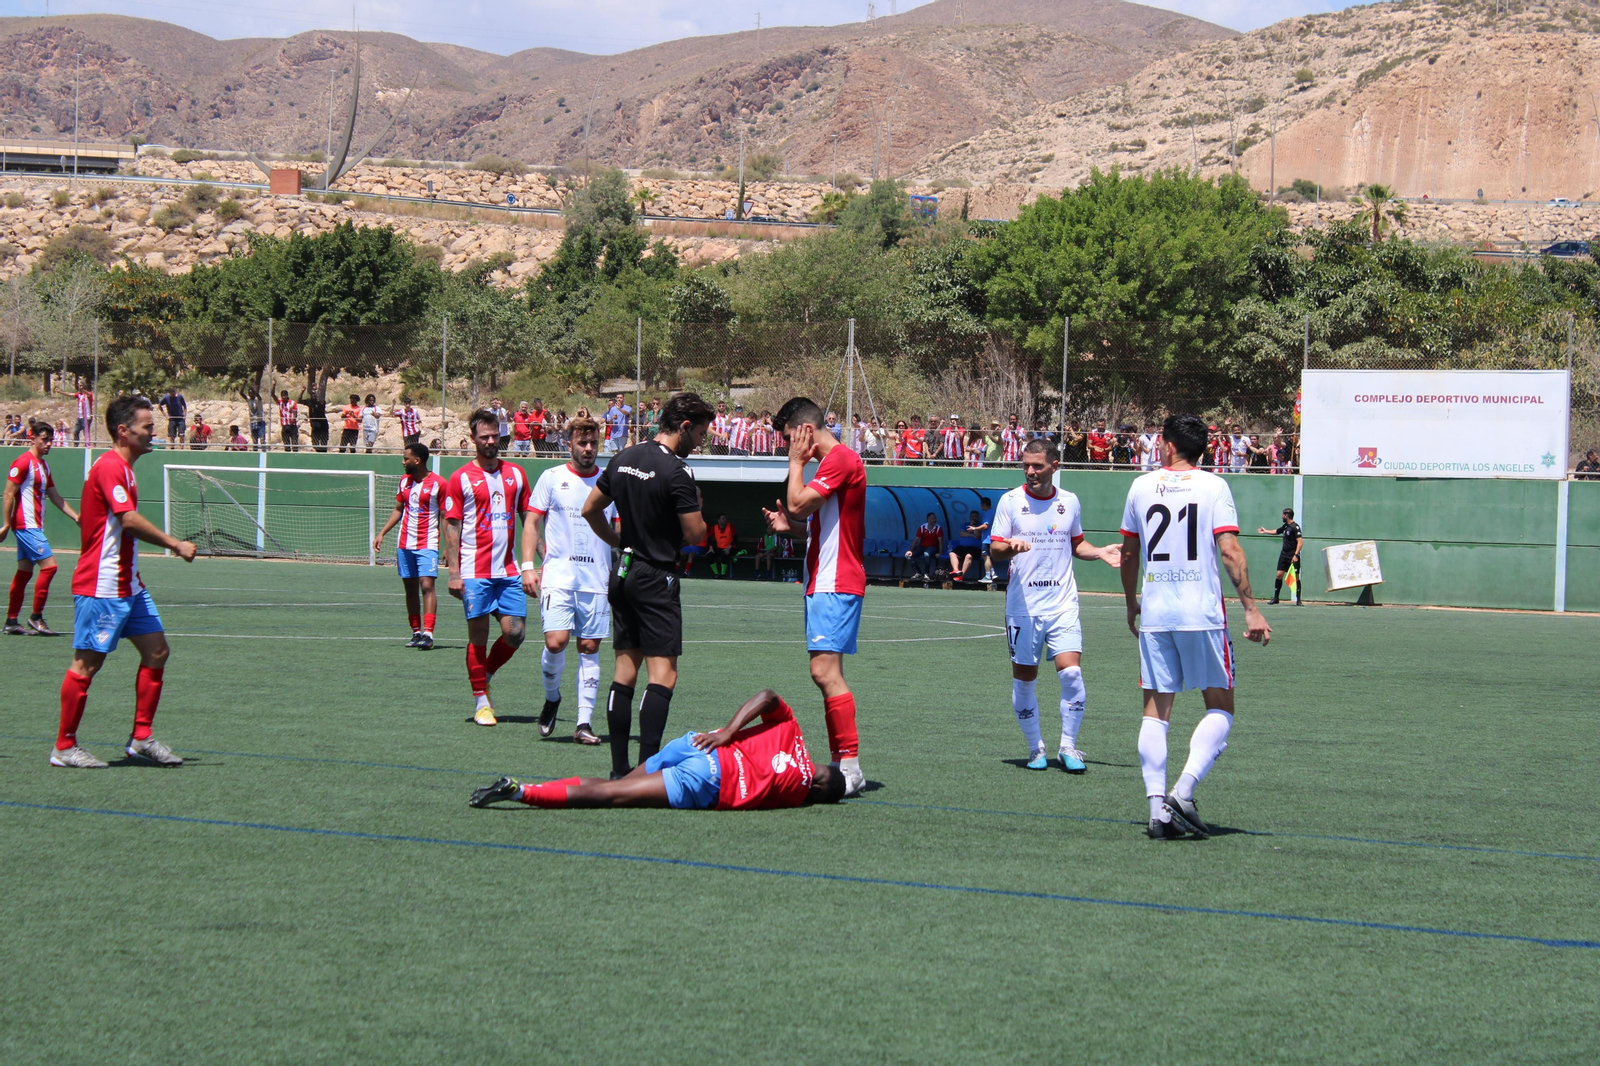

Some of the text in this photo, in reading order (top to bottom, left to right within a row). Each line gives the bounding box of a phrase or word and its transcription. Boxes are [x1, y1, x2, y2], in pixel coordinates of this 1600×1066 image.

[1354, 394, 1545, 404] COMPLEJO DEPORTIVO MUNICIPAL
[1383, 461, 1535, 473] CIUDAD DEPORTIVA LOS ANGELES
[1146, 503, 1198, 562] 21
[1008, 625, 1021, 646] 17
